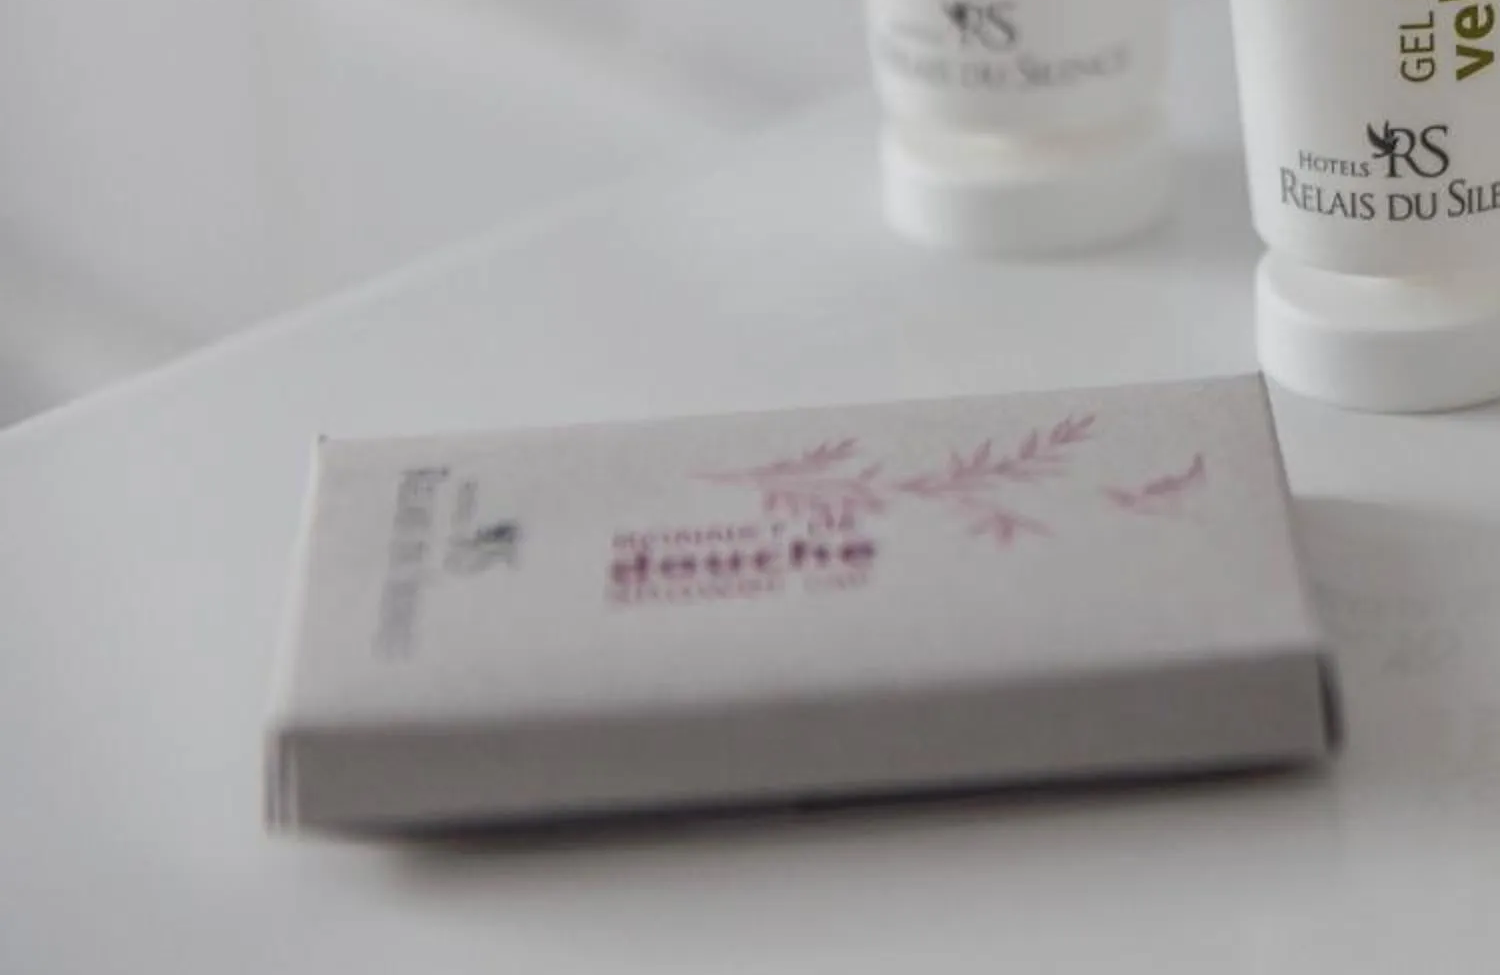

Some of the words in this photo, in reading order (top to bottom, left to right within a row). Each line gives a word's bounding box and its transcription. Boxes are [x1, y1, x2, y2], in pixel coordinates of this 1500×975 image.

[1398, 8, 1438, 84] GEL
[1298, 149, 1372, 178] HOTELS
[1380, 122, 1450, 178] RS
[1279, 165, 1377, 222] RELAIS
[1387, 190, 1438, 222] DU
